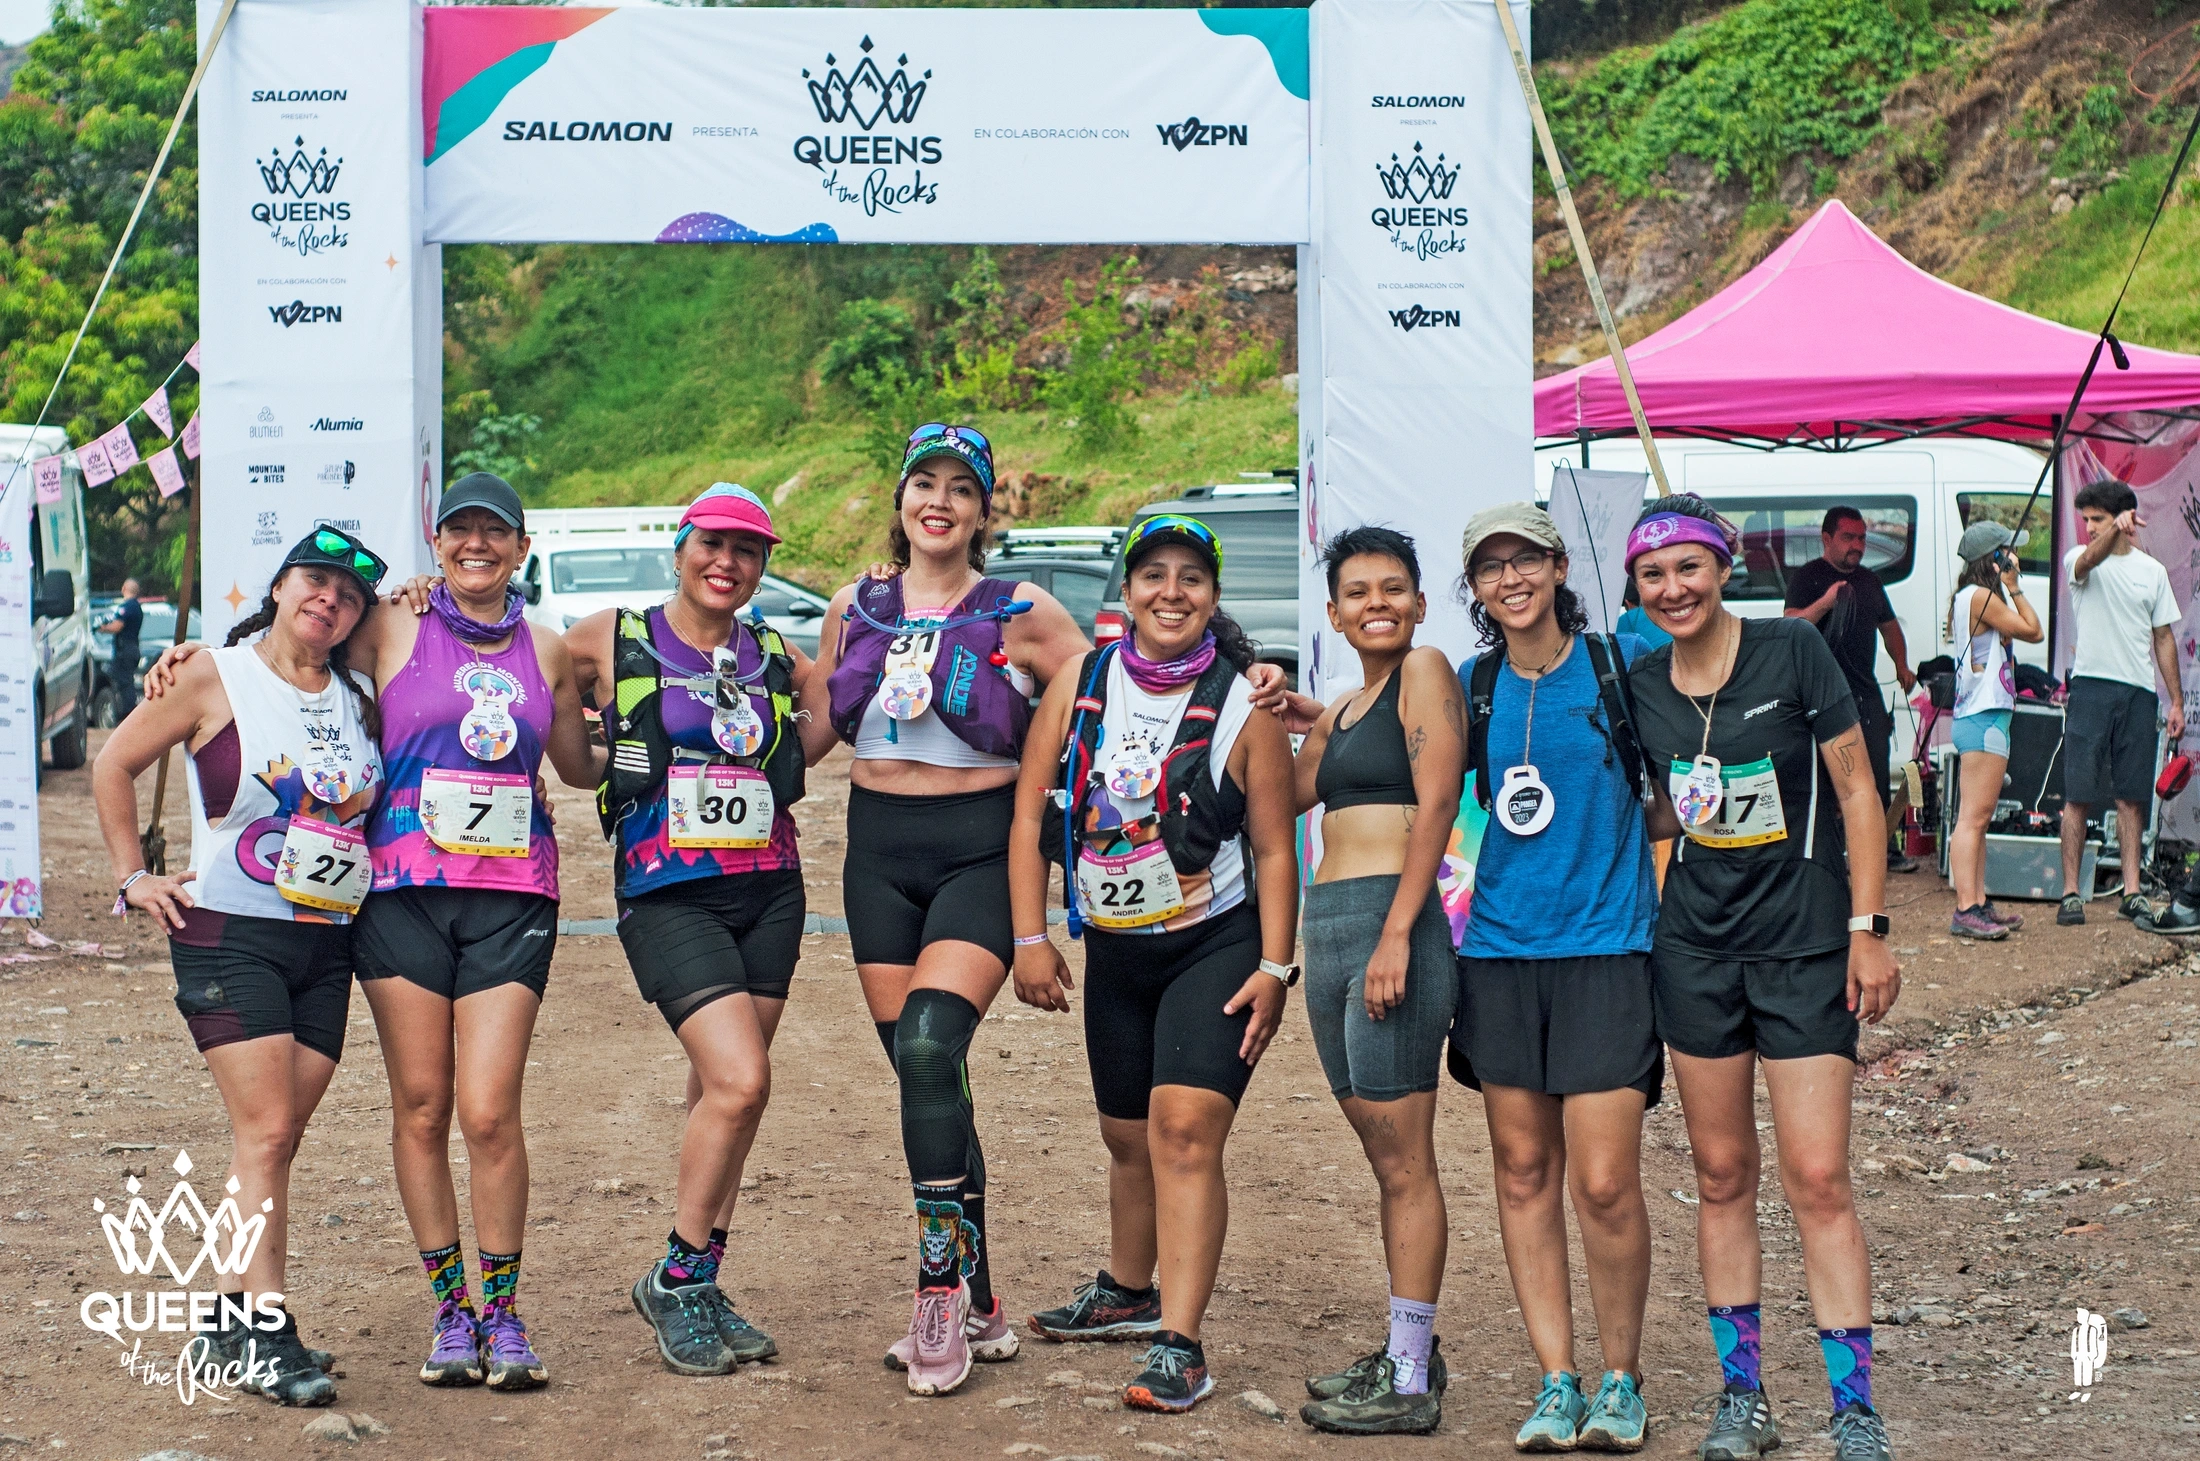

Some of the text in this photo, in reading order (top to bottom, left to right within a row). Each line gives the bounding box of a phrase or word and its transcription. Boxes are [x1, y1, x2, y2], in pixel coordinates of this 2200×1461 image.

[252, 89, 348, 102] SALOMON
[1371, 95, 1465, 108] SALOMON
[503, 120, 673, 142] SALOMON
[692, 126, 759, 138] PRESENTA
[974, 126, 1130, 139] EN COLABORACIÓN CON
[793, 135, 942, 174] QUEENS
[822, 167, 939, 217] of the Rocks
[250, 201, 351, 228] QUEENS
[1371, 207, 1469, 233] QUEENS
[270, 223, 350, 256] of the Rocks
[1390, 228, 1467, 261] of the Rocks
[269, 277, 328, 285] COLABORACIÓN
[1377, 281, 1465, 290] EN COLABORACIÓN CON
[248, 464, 286, 474] MOUNTAIN
[263, 475, 285, 484] BITES
[333, 519, 361, 530] PANGEA
[479, 661, 495, 670] DE
[1743, 699, 1780, 720] SPRINT
[471, 783, 491, 794] 13K
[717, 779, 734, 788] 13K
[464, 802, 493, 831] 7
[699, 795, 748, 825] 30
[1514, 812, 1530, 824] 2023
[458, 834, 491, 843] IMELDA
[1713, 828, 1736, 836] ROSA
[334, 839, 351, 850] 13K
[306, 854, 357, 887] 27
[1106, 866, 1125, 875] 13K
[1100, 878, 1146, 907] 22
[1111, 907, 1144, 917] ANDREA
[1404, 1310, 1428, 1326] YOU
